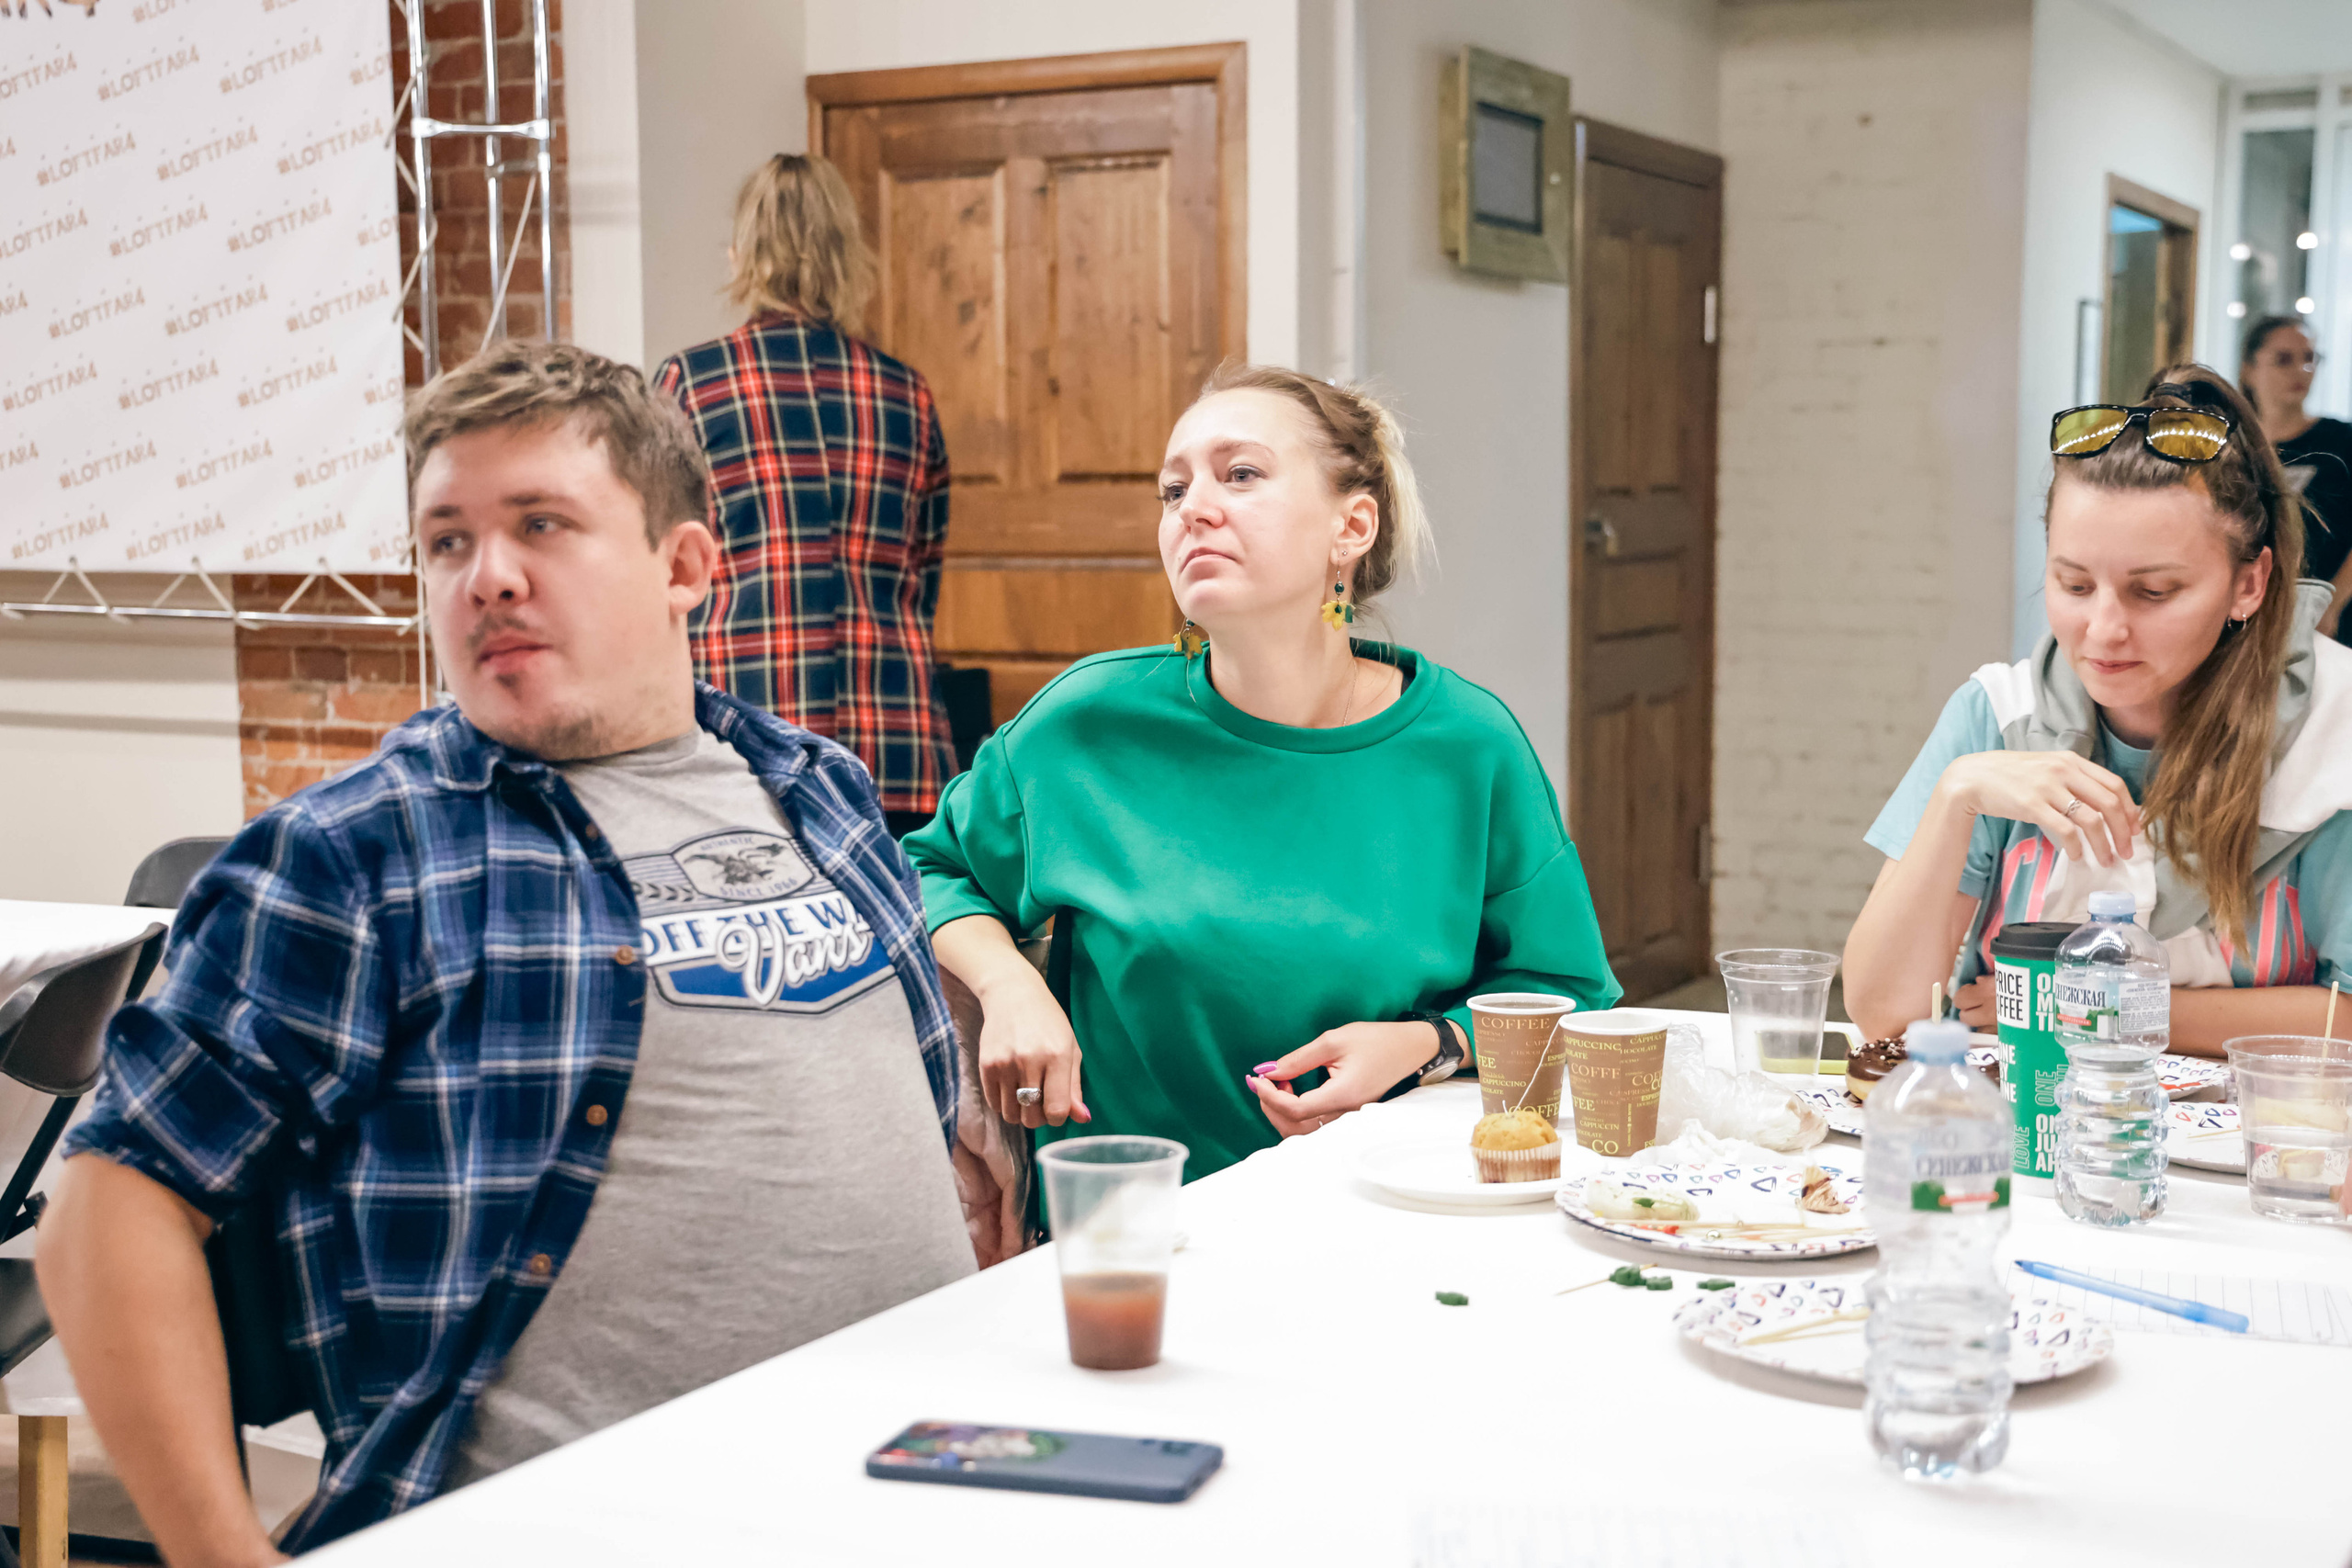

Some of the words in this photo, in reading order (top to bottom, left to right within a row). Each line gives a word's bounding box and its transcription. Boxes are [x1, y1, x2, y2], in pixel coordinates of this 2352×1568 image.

[700, 836, 753, 851] AUTHENTIC
[719, 886, 763, 897] SINCE
[718, 919, 867, 1004] Vans
[1481, 1016, 1550, 1030] COFFEE
[1482, 1077, 1527, 1088] CAPPUCCINO
[2035, 1069, 2057, 1107] ONE
[2014, 1124, 2030, 1169] LOVE
